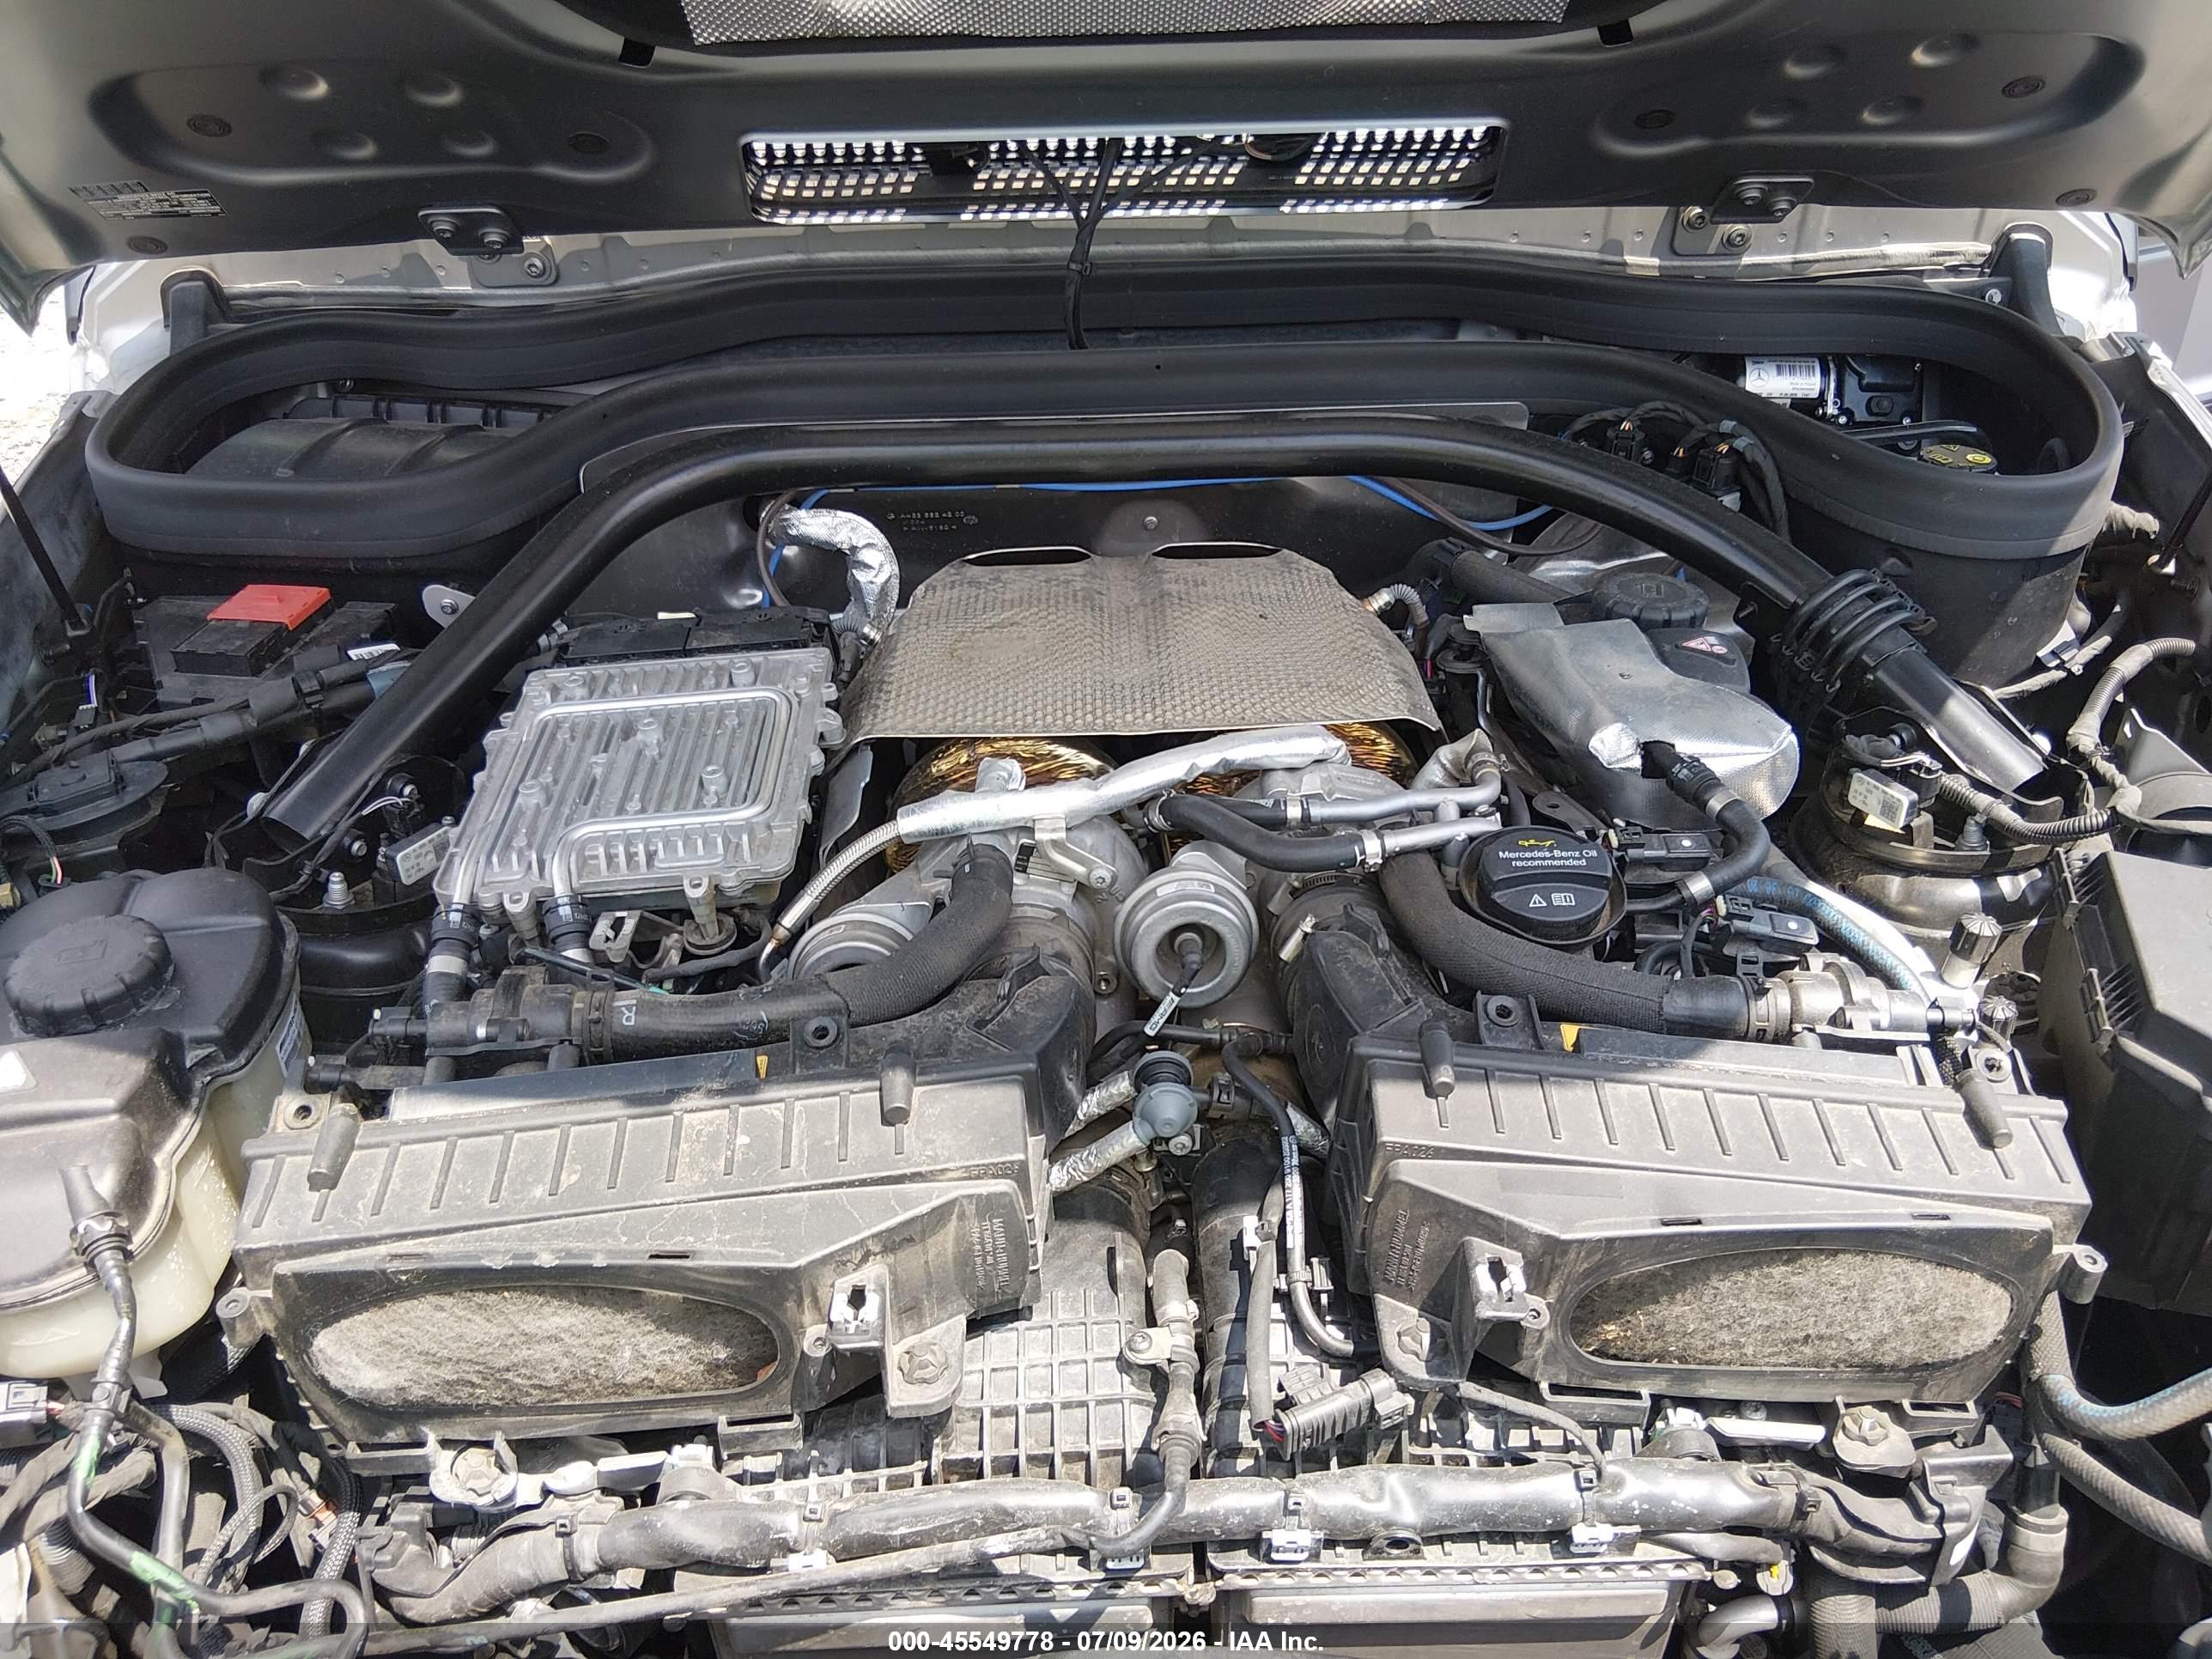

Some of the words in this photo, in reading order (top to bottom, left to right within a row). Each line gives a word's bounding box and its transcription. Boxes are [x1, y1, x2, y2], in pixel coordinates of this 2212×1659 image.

[1498, 849, 1580, 860] Mercedes-Benz
[1582, 849, 1598, 858] Oil
[1511, 858, 1587, 867] recommended
